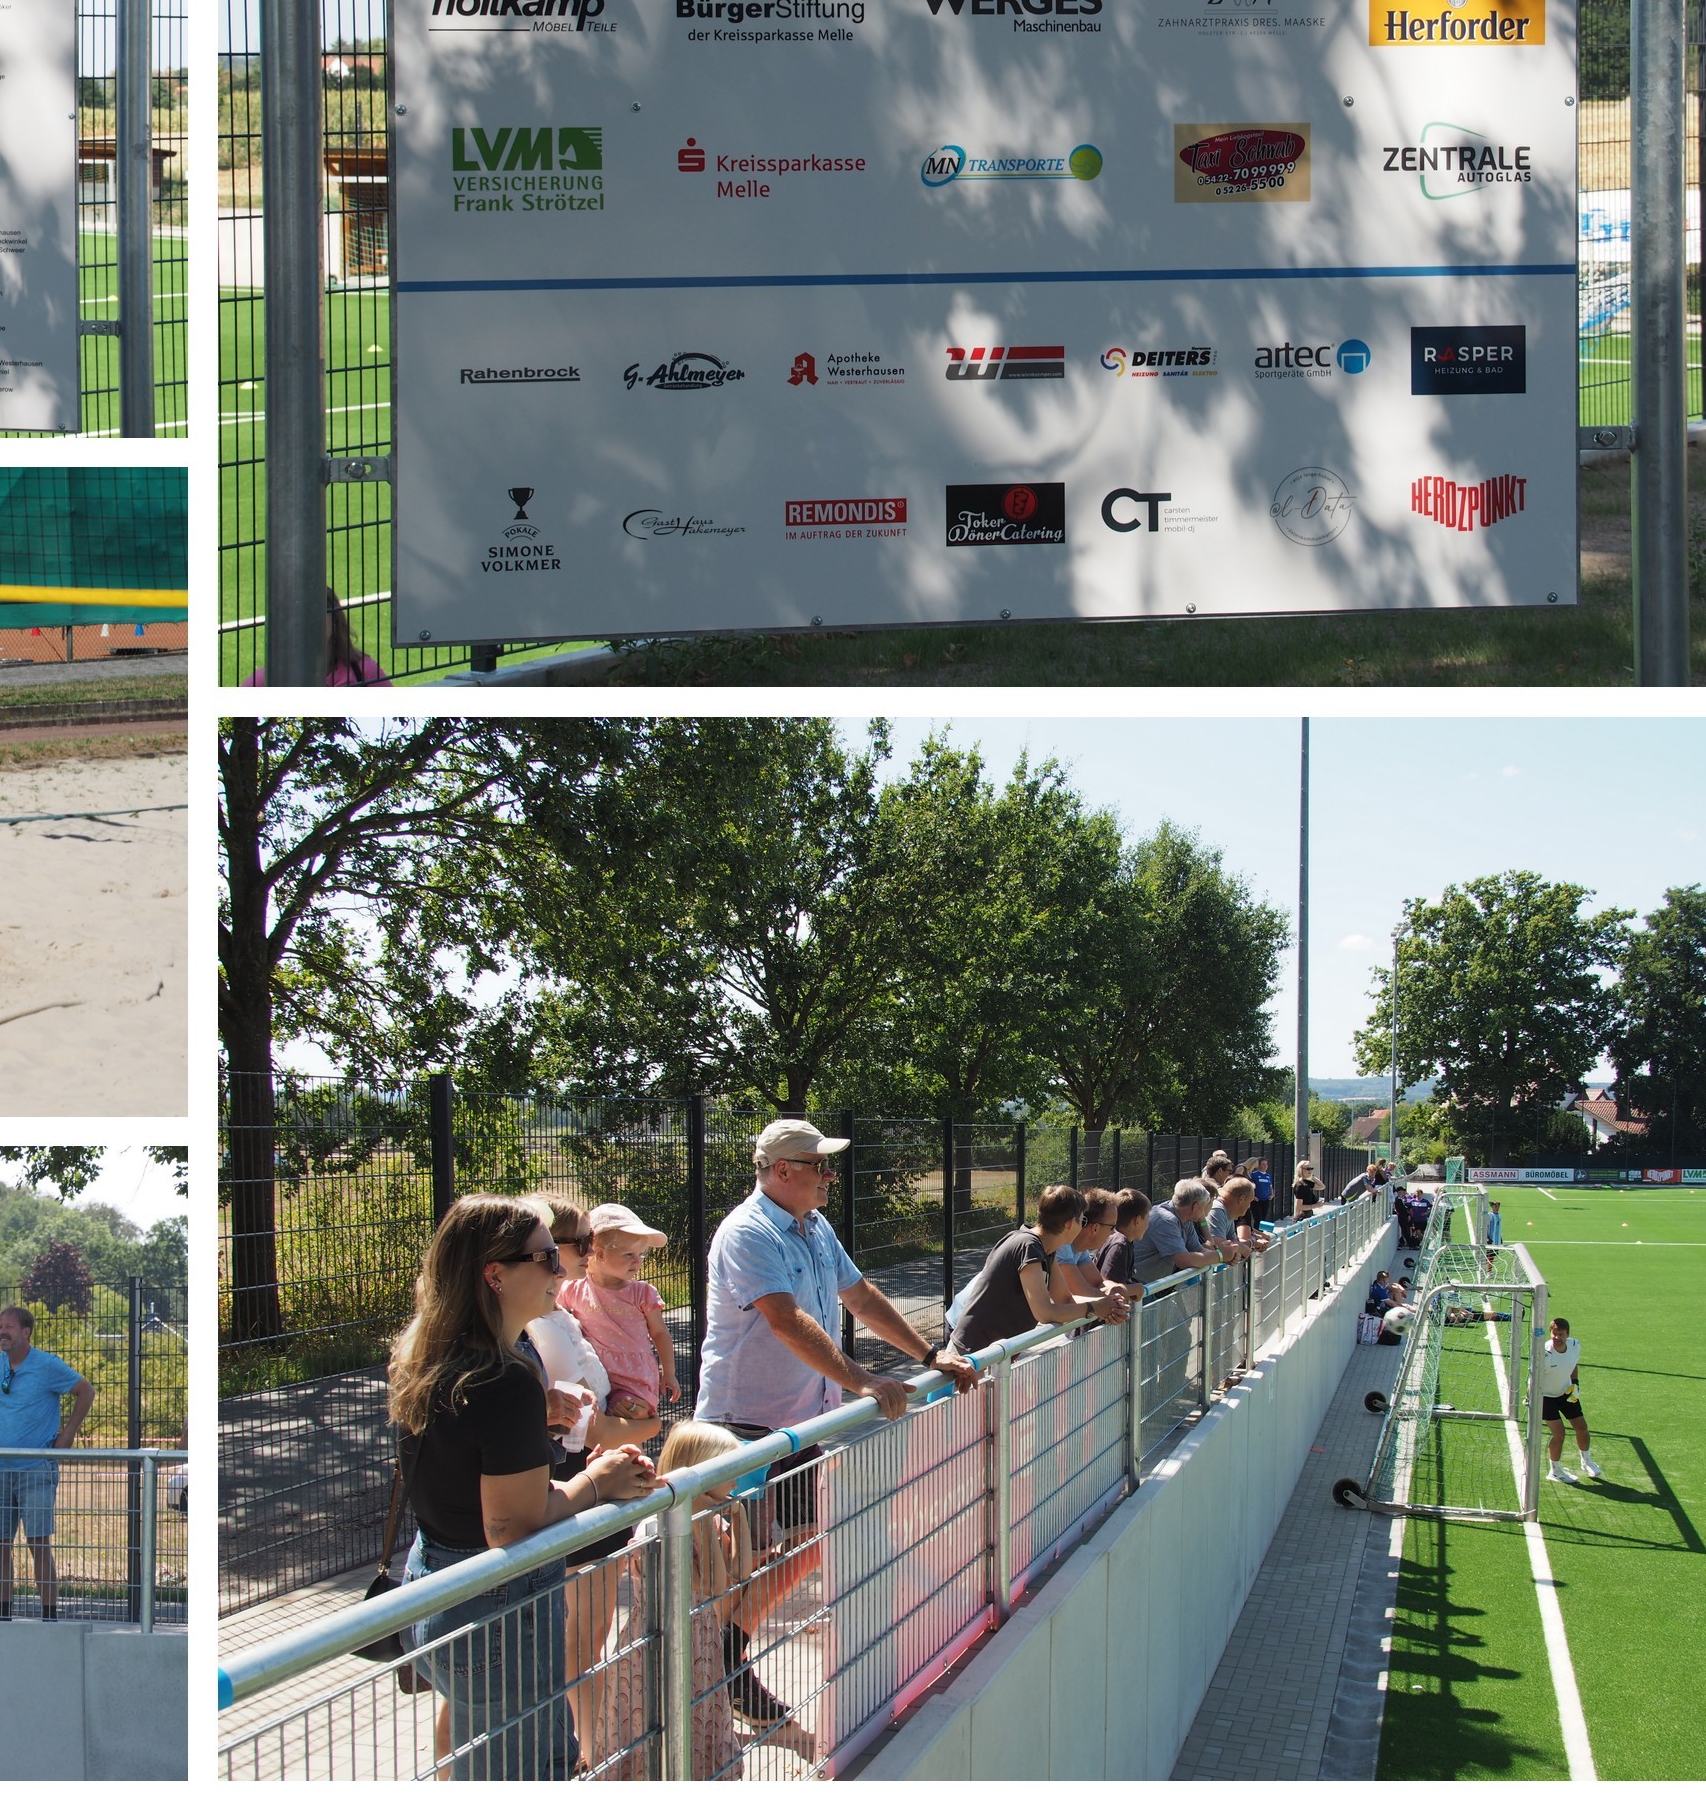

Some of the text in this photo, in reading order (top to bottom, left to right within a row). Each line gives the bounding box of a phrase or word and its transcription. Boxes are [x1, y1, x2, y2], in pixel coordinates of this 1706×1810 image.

[532, 21, 618, 33] MÖBEL TEILE
[1013, 18, 1102, 33] Maschinenbau
[1158, 17, 1326, 28] ZAHNARZTPRAXIS DRES. MAASKE
[1385, 8, 1531, 44] Herforder
[687, 28, 854, 45] der Kreissparkasse Melle
[451, 127, 554, 172] LVM
[1187, 134, 1296, 173] Taxi Schwab
[716, 154, 867, 177] Kreissparkasse
[924, 153, 1065, 175] MN TRANSPORTE
[1383, 146, 1532, 172] ZENTRALE
[453, 176, 604, 191] VERSICHERUNG
[1457, 170, 1532, 183] AUTOGLAS
[716, 180, 771, 198] Melle
[453, 193, 605, 212] Frank Strötzel
[827, 352, 881, 364] Apotheke
[1131, 349, 1211, 367] DEITERS
[1254, 342, 1331, 368] artec
[1423, 345, 1514, 363] RASPER
[460, 365, 580, 385] Rahenbrock
[623, 361, 746, 391] G. Ahlmeyer
[828, 366, 905, 377] Westerhausen
[1254, 369, 1332, 379] Sportgeräte GmbH
[1434, 367, 1474, 375] HEIZUNG
[1485, 366, 1504, 374] BAD
[1101, 487, 1172, 533] CT
[1410, 473, 1527, 532] HERDZPUNKT
[958, 510, 1006, 530] Toker
[503, 526, 538, 540] POKALE
[786, 528, 907, 540] IM AUFTRAG DER ZUKUNFT
[488, 545, 555, 559] SIMONE
[481, 559, 562, 573] VOLKMER
[1472, 1170, 1569, 1179] ASSMANN BÜROMÖBEL
[1683, 1169, 1702, 1179] LVM
